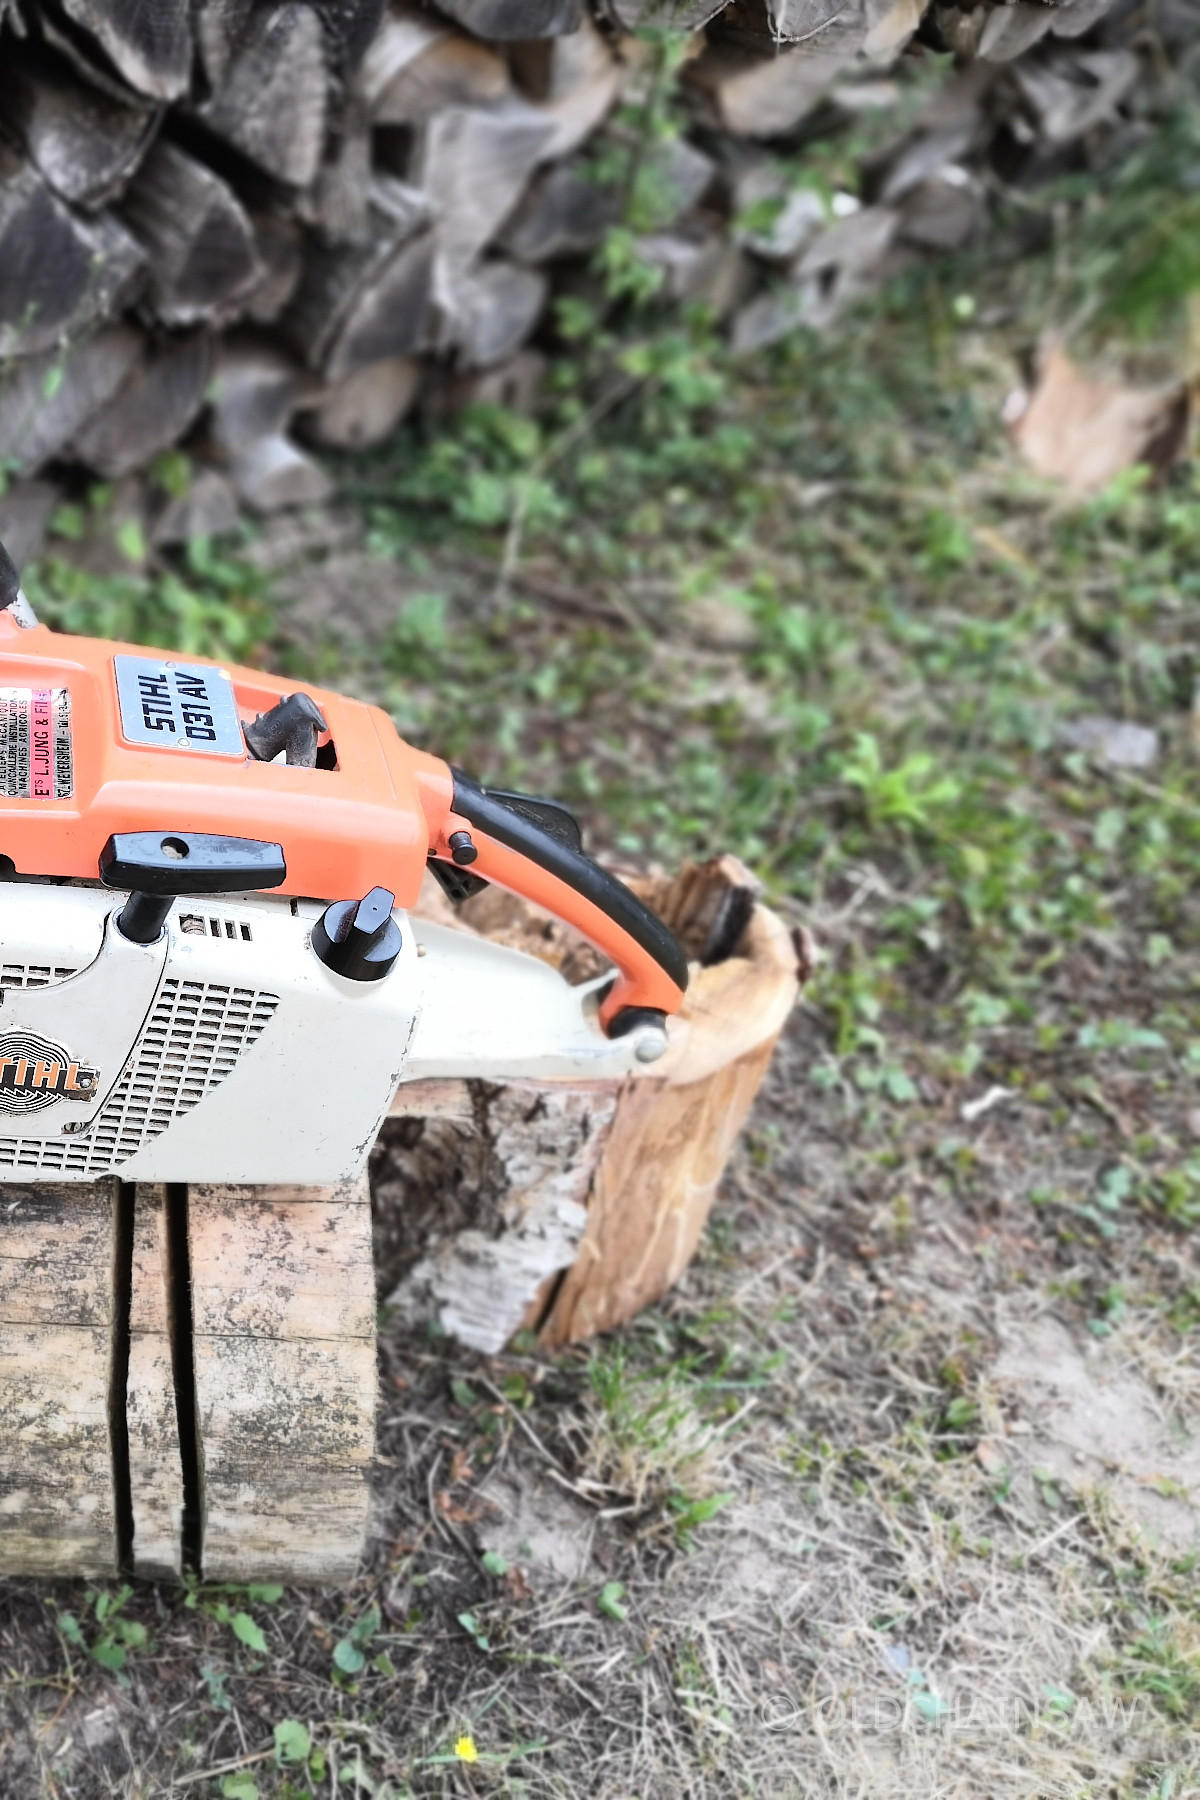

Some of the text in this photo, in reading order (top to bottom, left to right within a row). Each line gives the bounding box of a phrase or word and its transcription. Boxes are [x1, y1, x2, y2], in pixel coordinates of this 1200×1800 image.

[35, 718, 49, 726] &
[137, 674, 176, 733] STIHL
[174, 671, 217, 741] 031 AV
[8, 744, 18, 796] QUINCAILLERIE
[19, 700, 28, 790] MACHINES AGRICOLES
